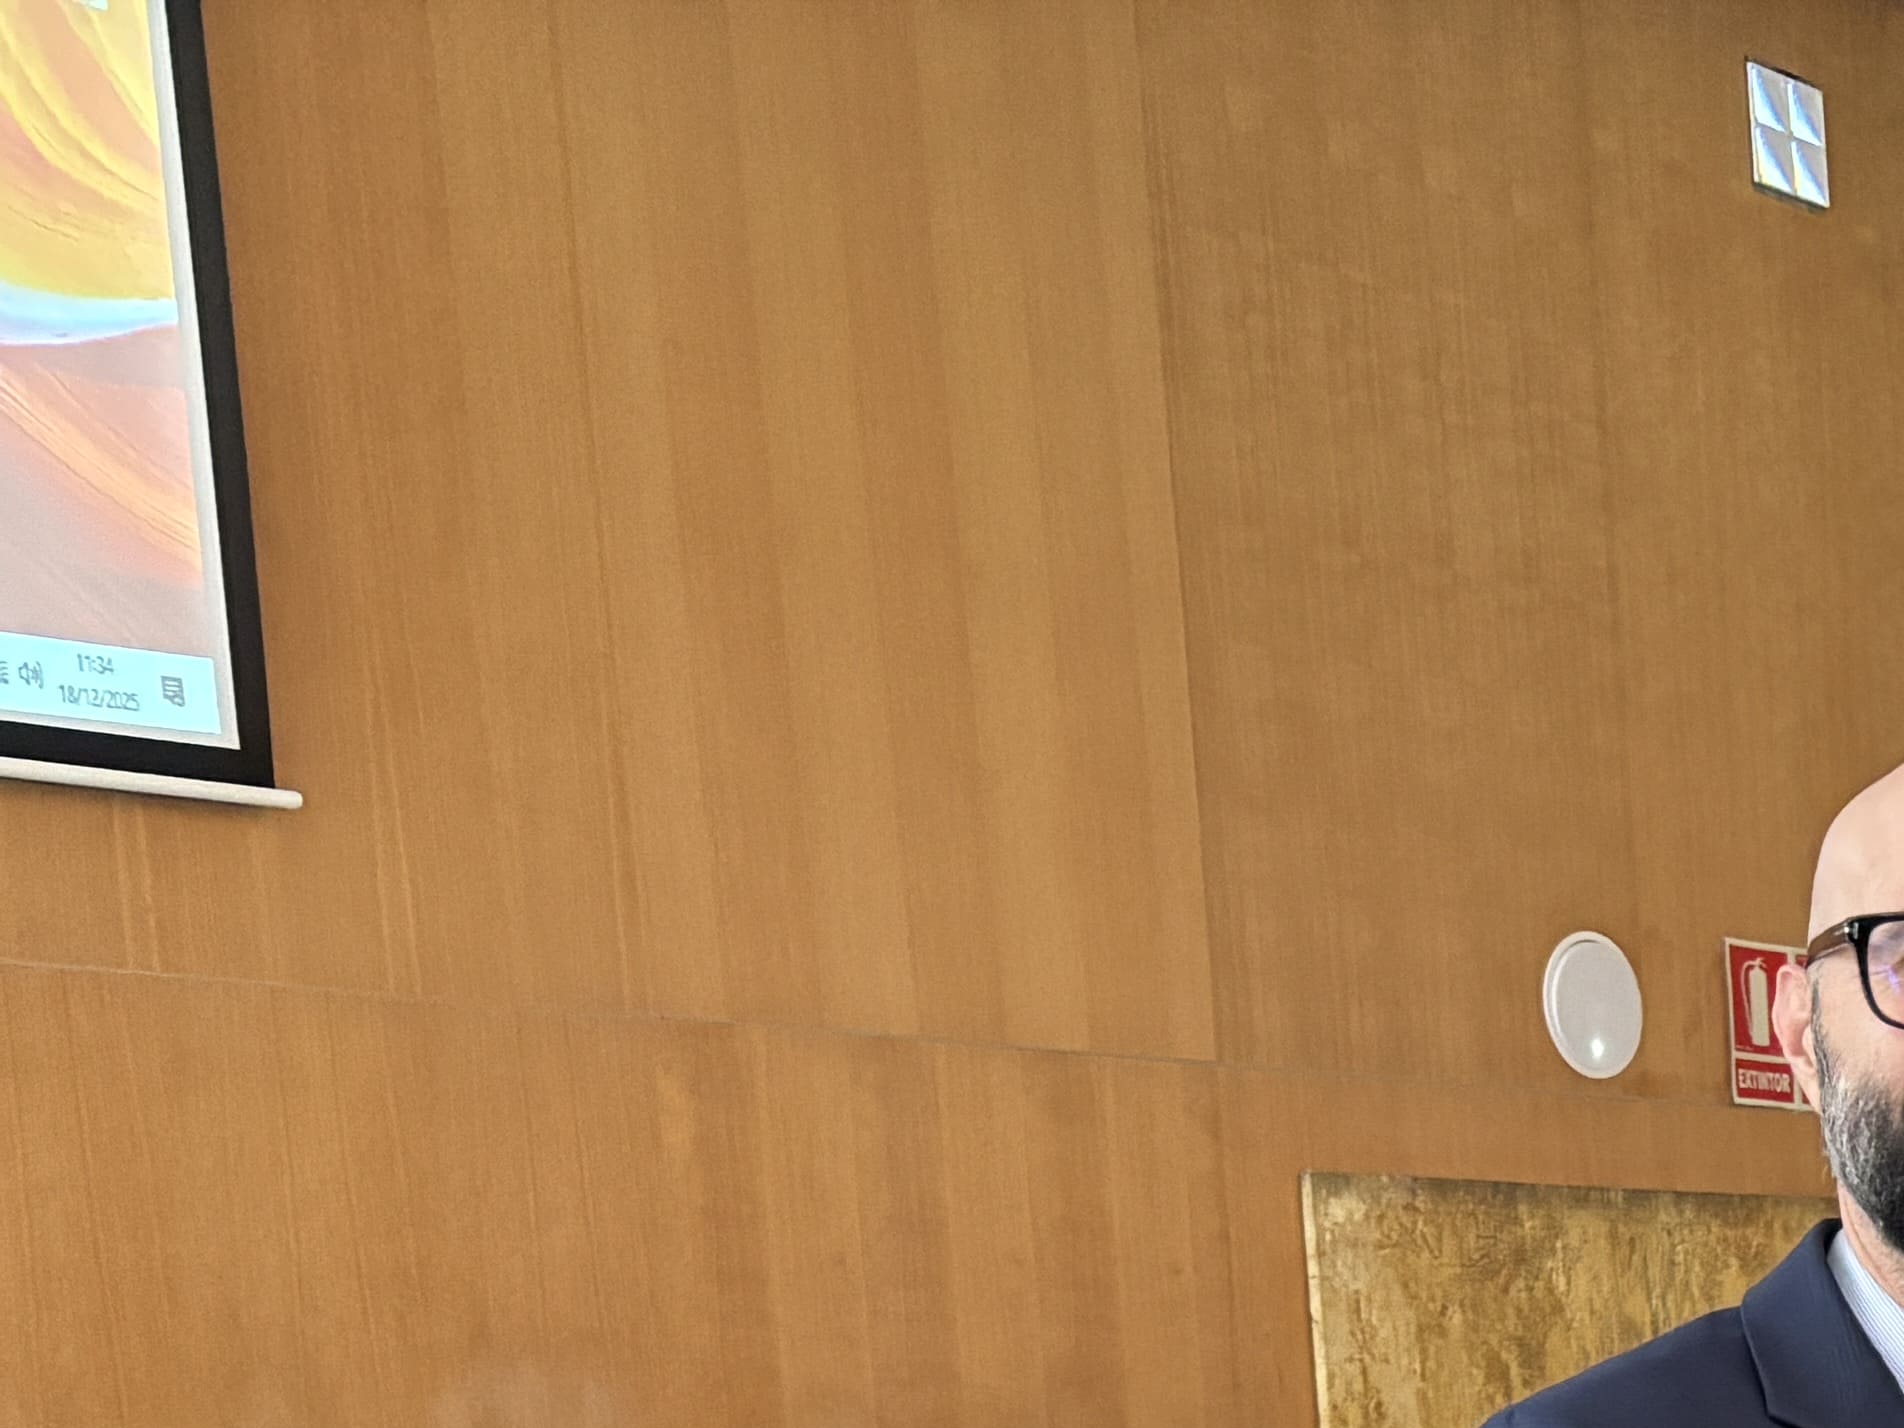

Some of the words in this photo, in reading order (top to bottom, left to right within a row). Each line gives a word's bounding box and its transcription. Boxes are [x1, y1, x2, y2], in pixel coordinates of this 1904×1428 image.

[77, 653, 115, 675] 11:34
[58, 685, 140, 711] 18/12/2025
[1738, 1068, 1791, 1093] EXTINTOR
